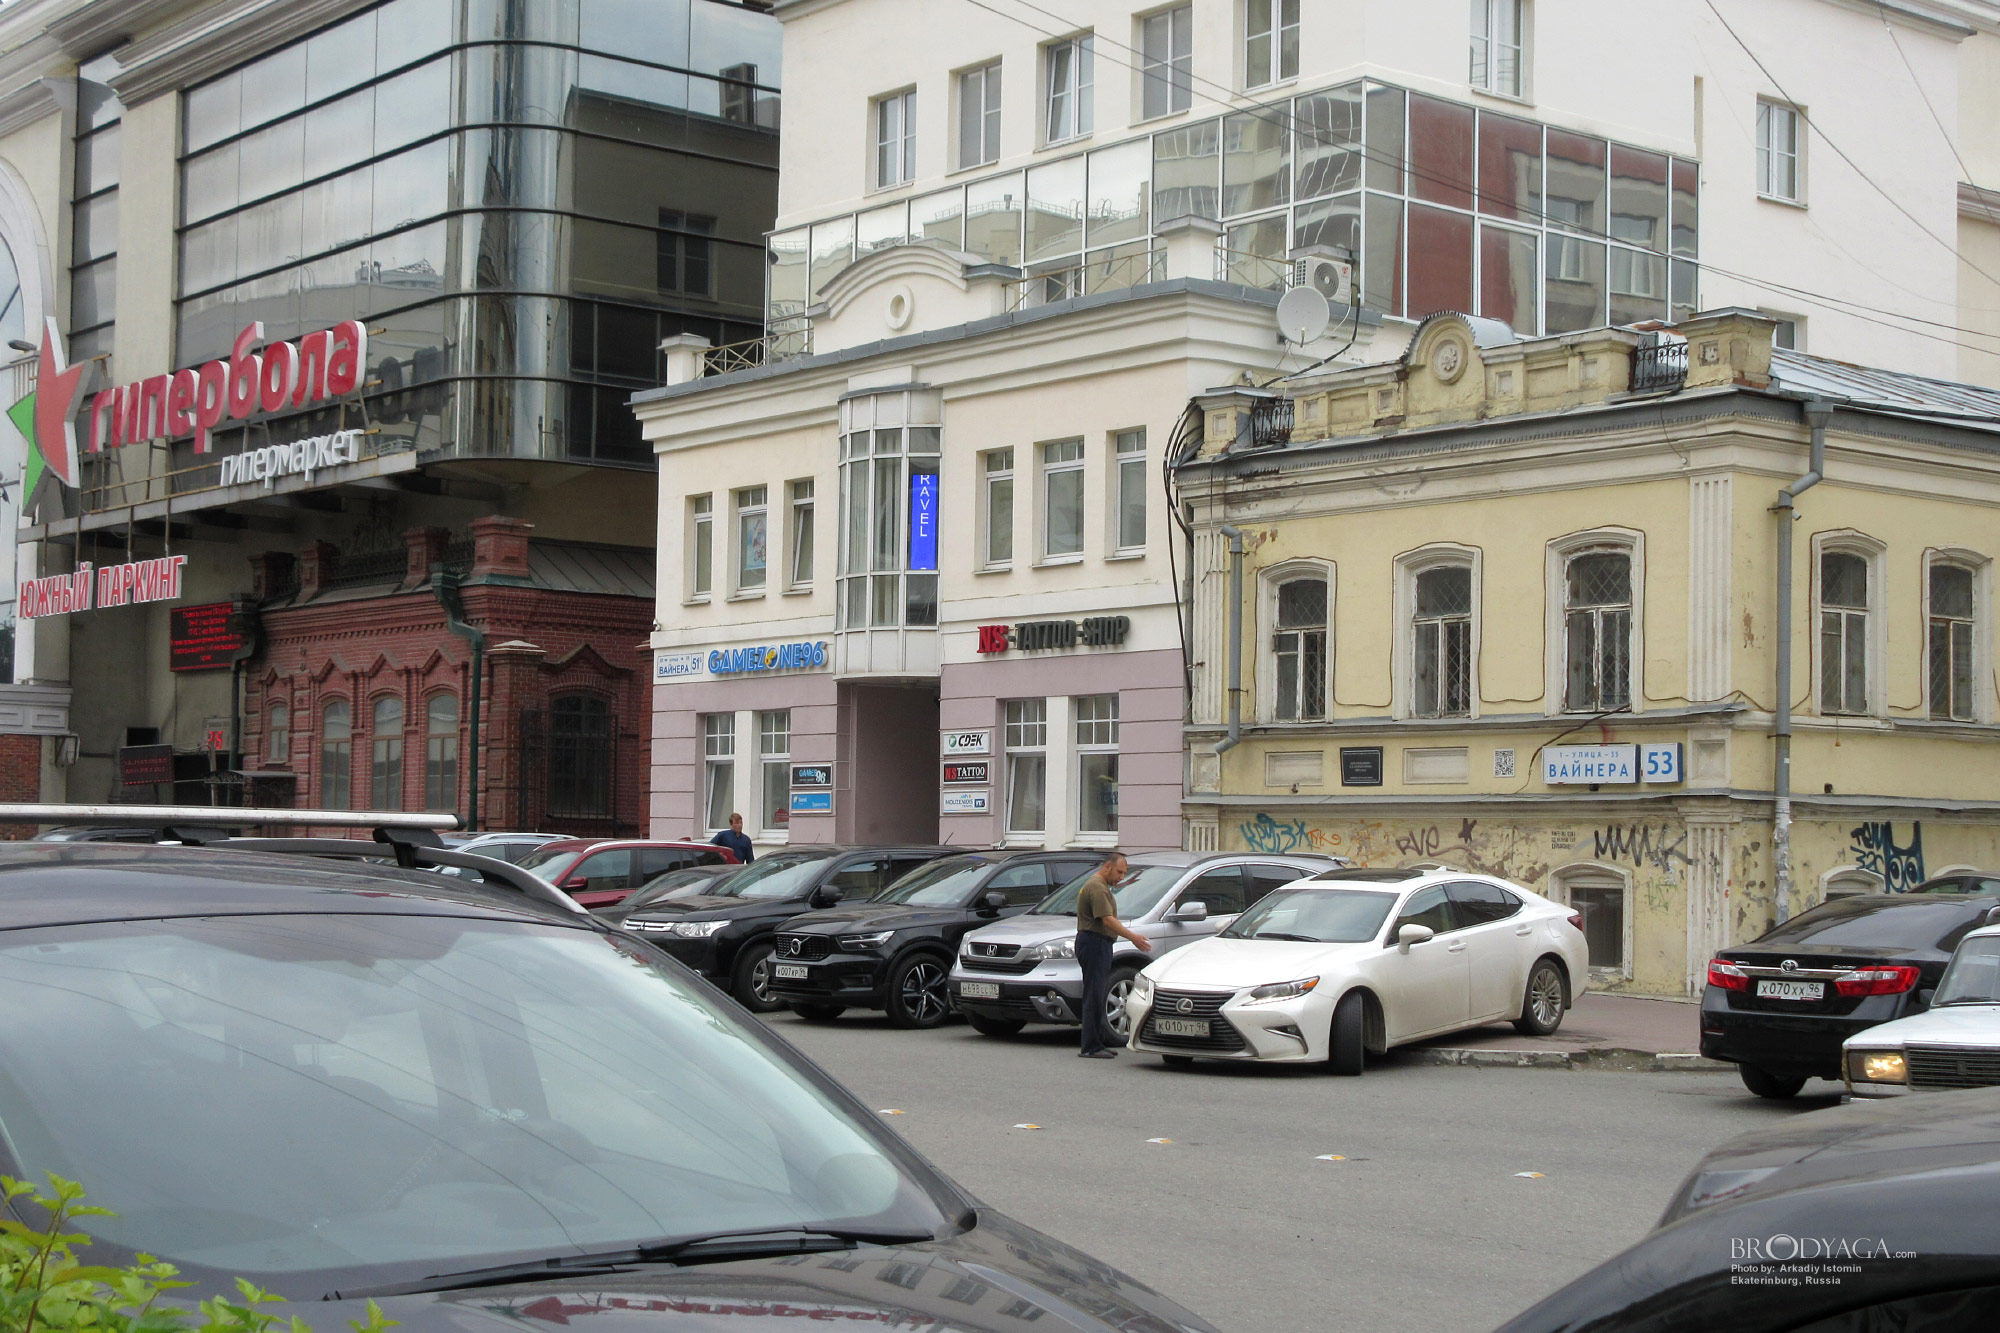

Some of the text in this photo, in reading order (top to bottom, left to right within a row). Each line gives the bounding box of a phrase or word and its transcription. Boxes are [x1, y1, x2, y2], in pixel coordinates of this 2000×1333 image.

[89, 320, 367, 454] гипербола
[220, 428, 365, 489] гипермаркет
[19, 555, 188, 619] ЮЖНЫЙ ПАРКИНГ
[659, 663, 690, 675] ВАЙНЕРА
[708, 641, 829, 674] GAMEZONE96
[958, 734, 983, 748] CDEK
[1549, 760, 1629, 778] ВАЙНЕРА
[1647, 751, 1673, 775] 53
